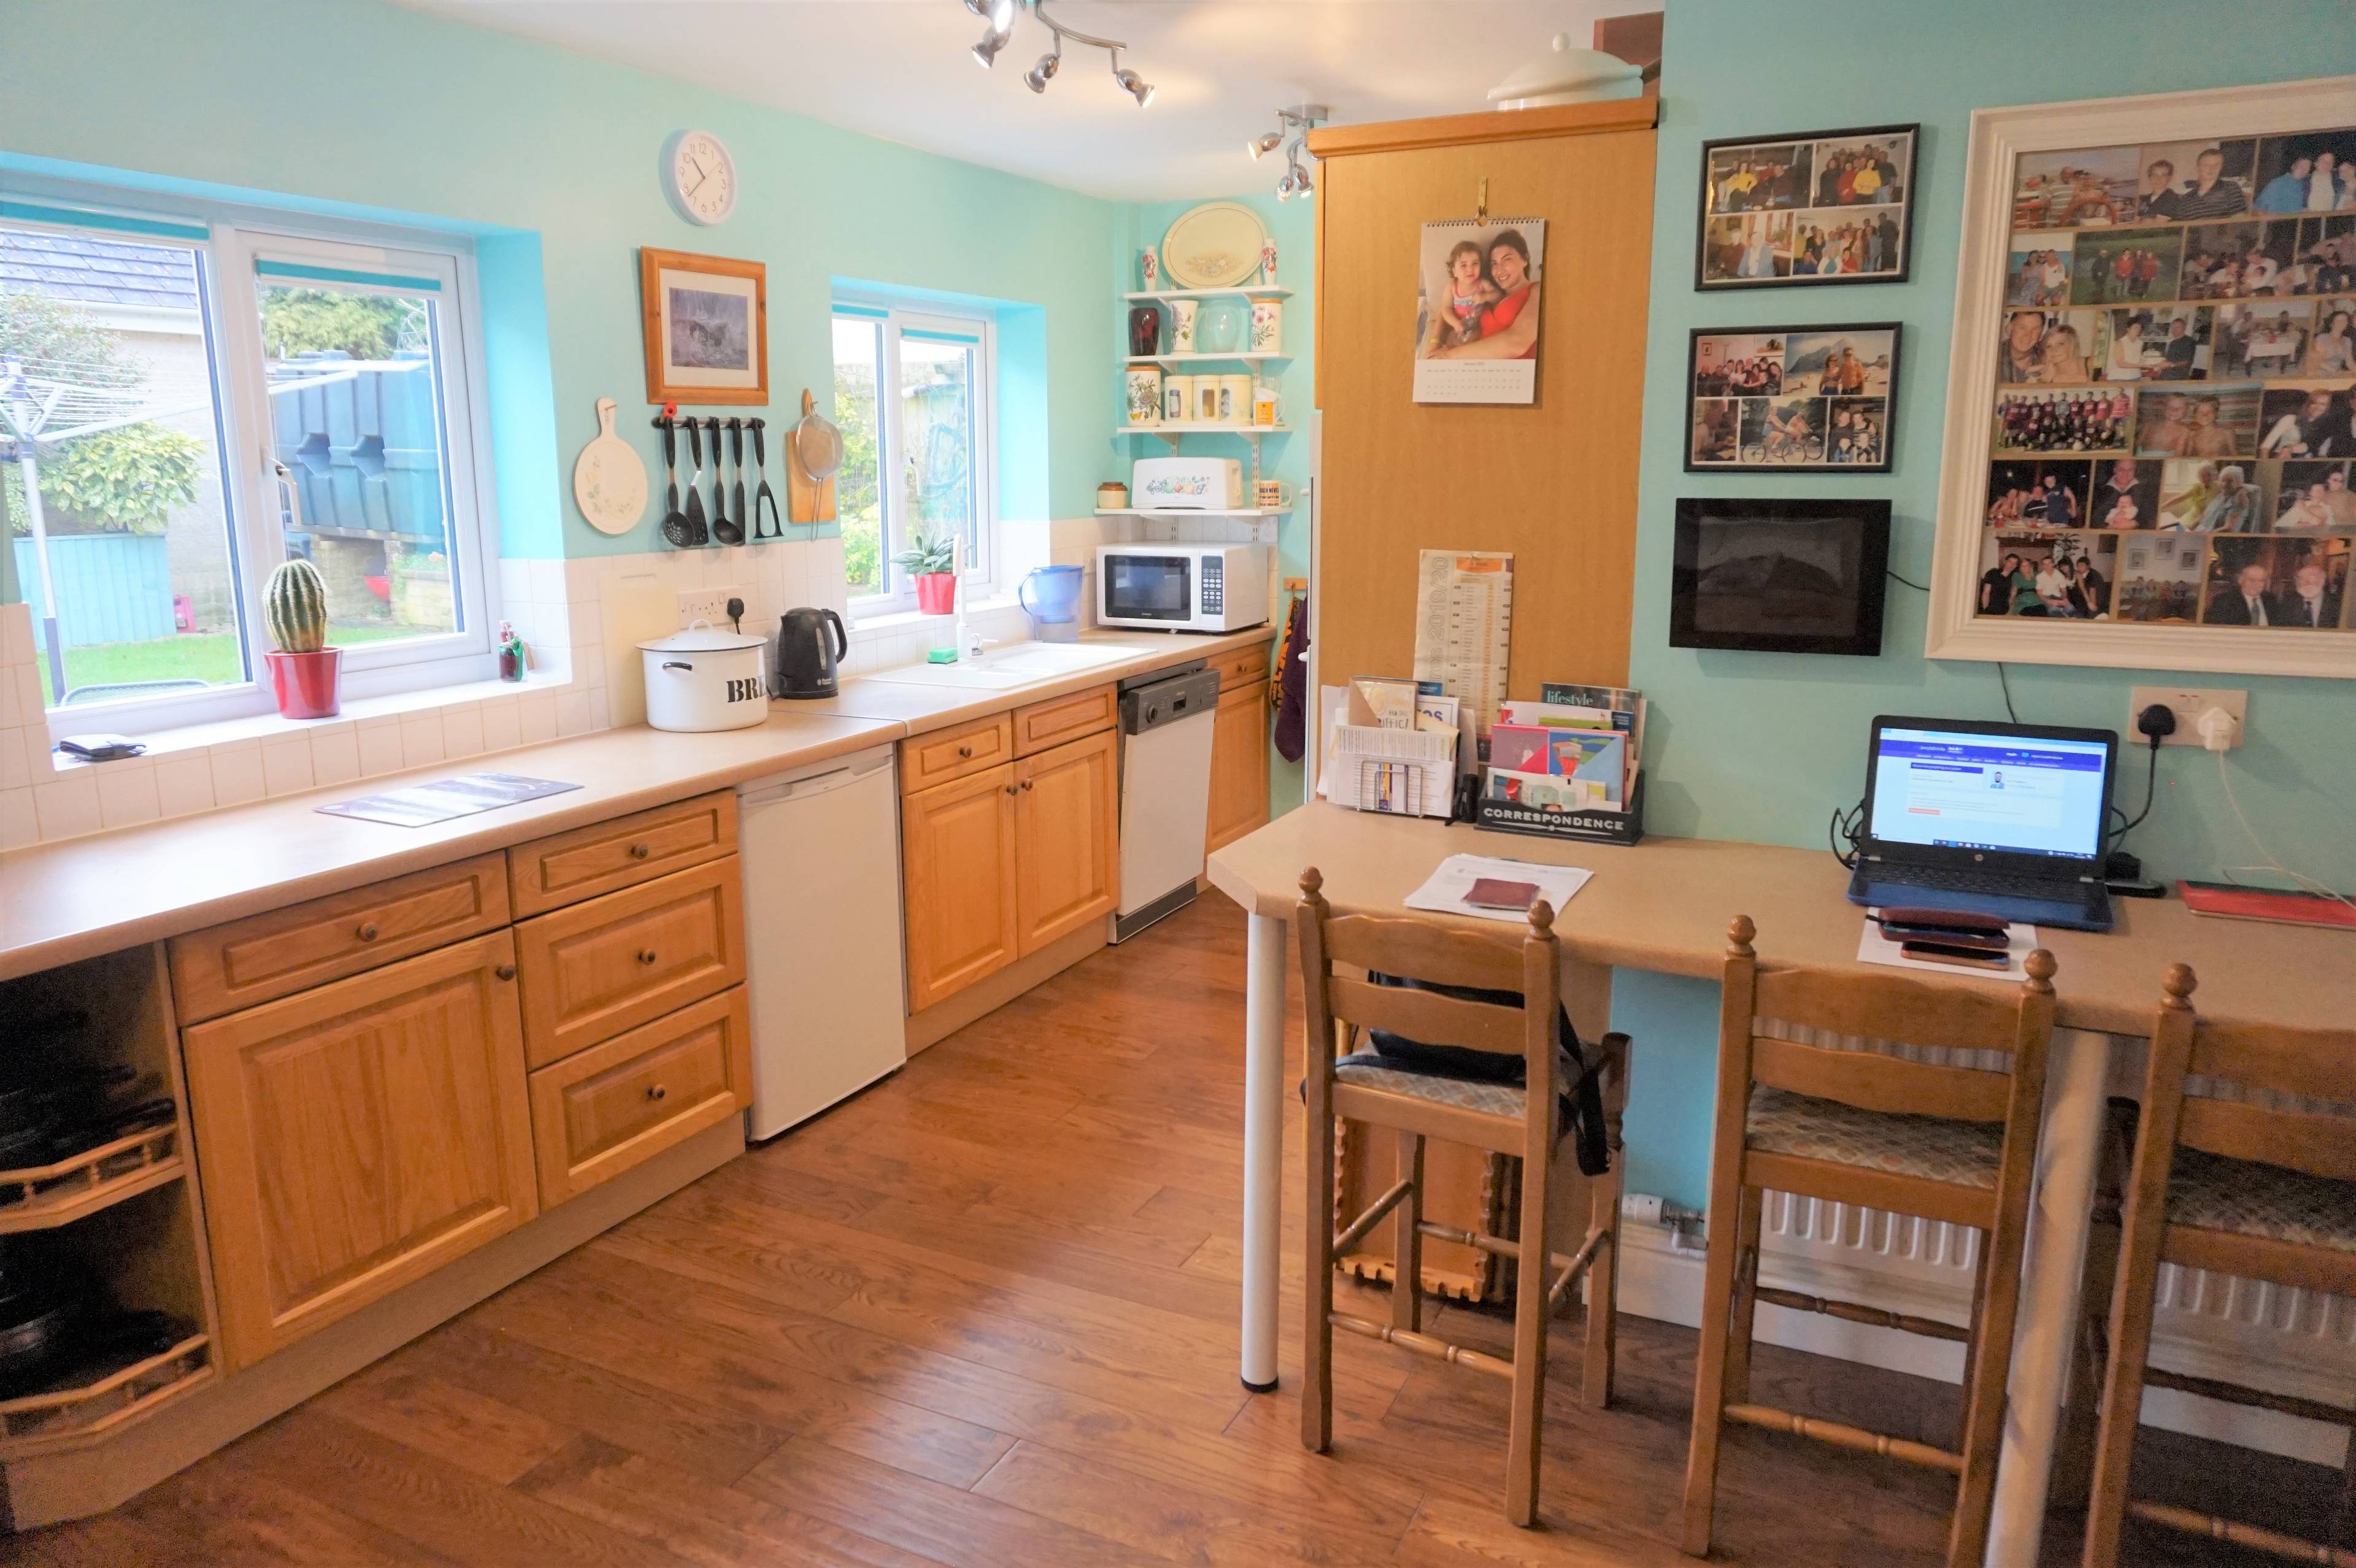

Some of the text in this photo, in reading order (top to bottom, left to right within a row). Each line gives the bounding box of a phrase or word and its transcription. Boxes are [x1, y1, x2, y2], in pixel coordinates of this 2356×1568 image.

[698, 142, 707, 155] 12
[682, 152, 691, 164] 10
[718, 162, 723, 174] 2
[722, 179, 726, 190] 3
[691, 196, 697, 206] 7
[718, 194, 723, 203] 4
[701, 202, 707, 212] 6
[712, 201, 717, 212] 5
[1428, 556, 1449, 641] 2019/20
[726, 675, 767, 703] BRE
[1546, 690, 1594, 707] lifestyle
[1483, 807, 1624, 831] CORRESPONDENCE
